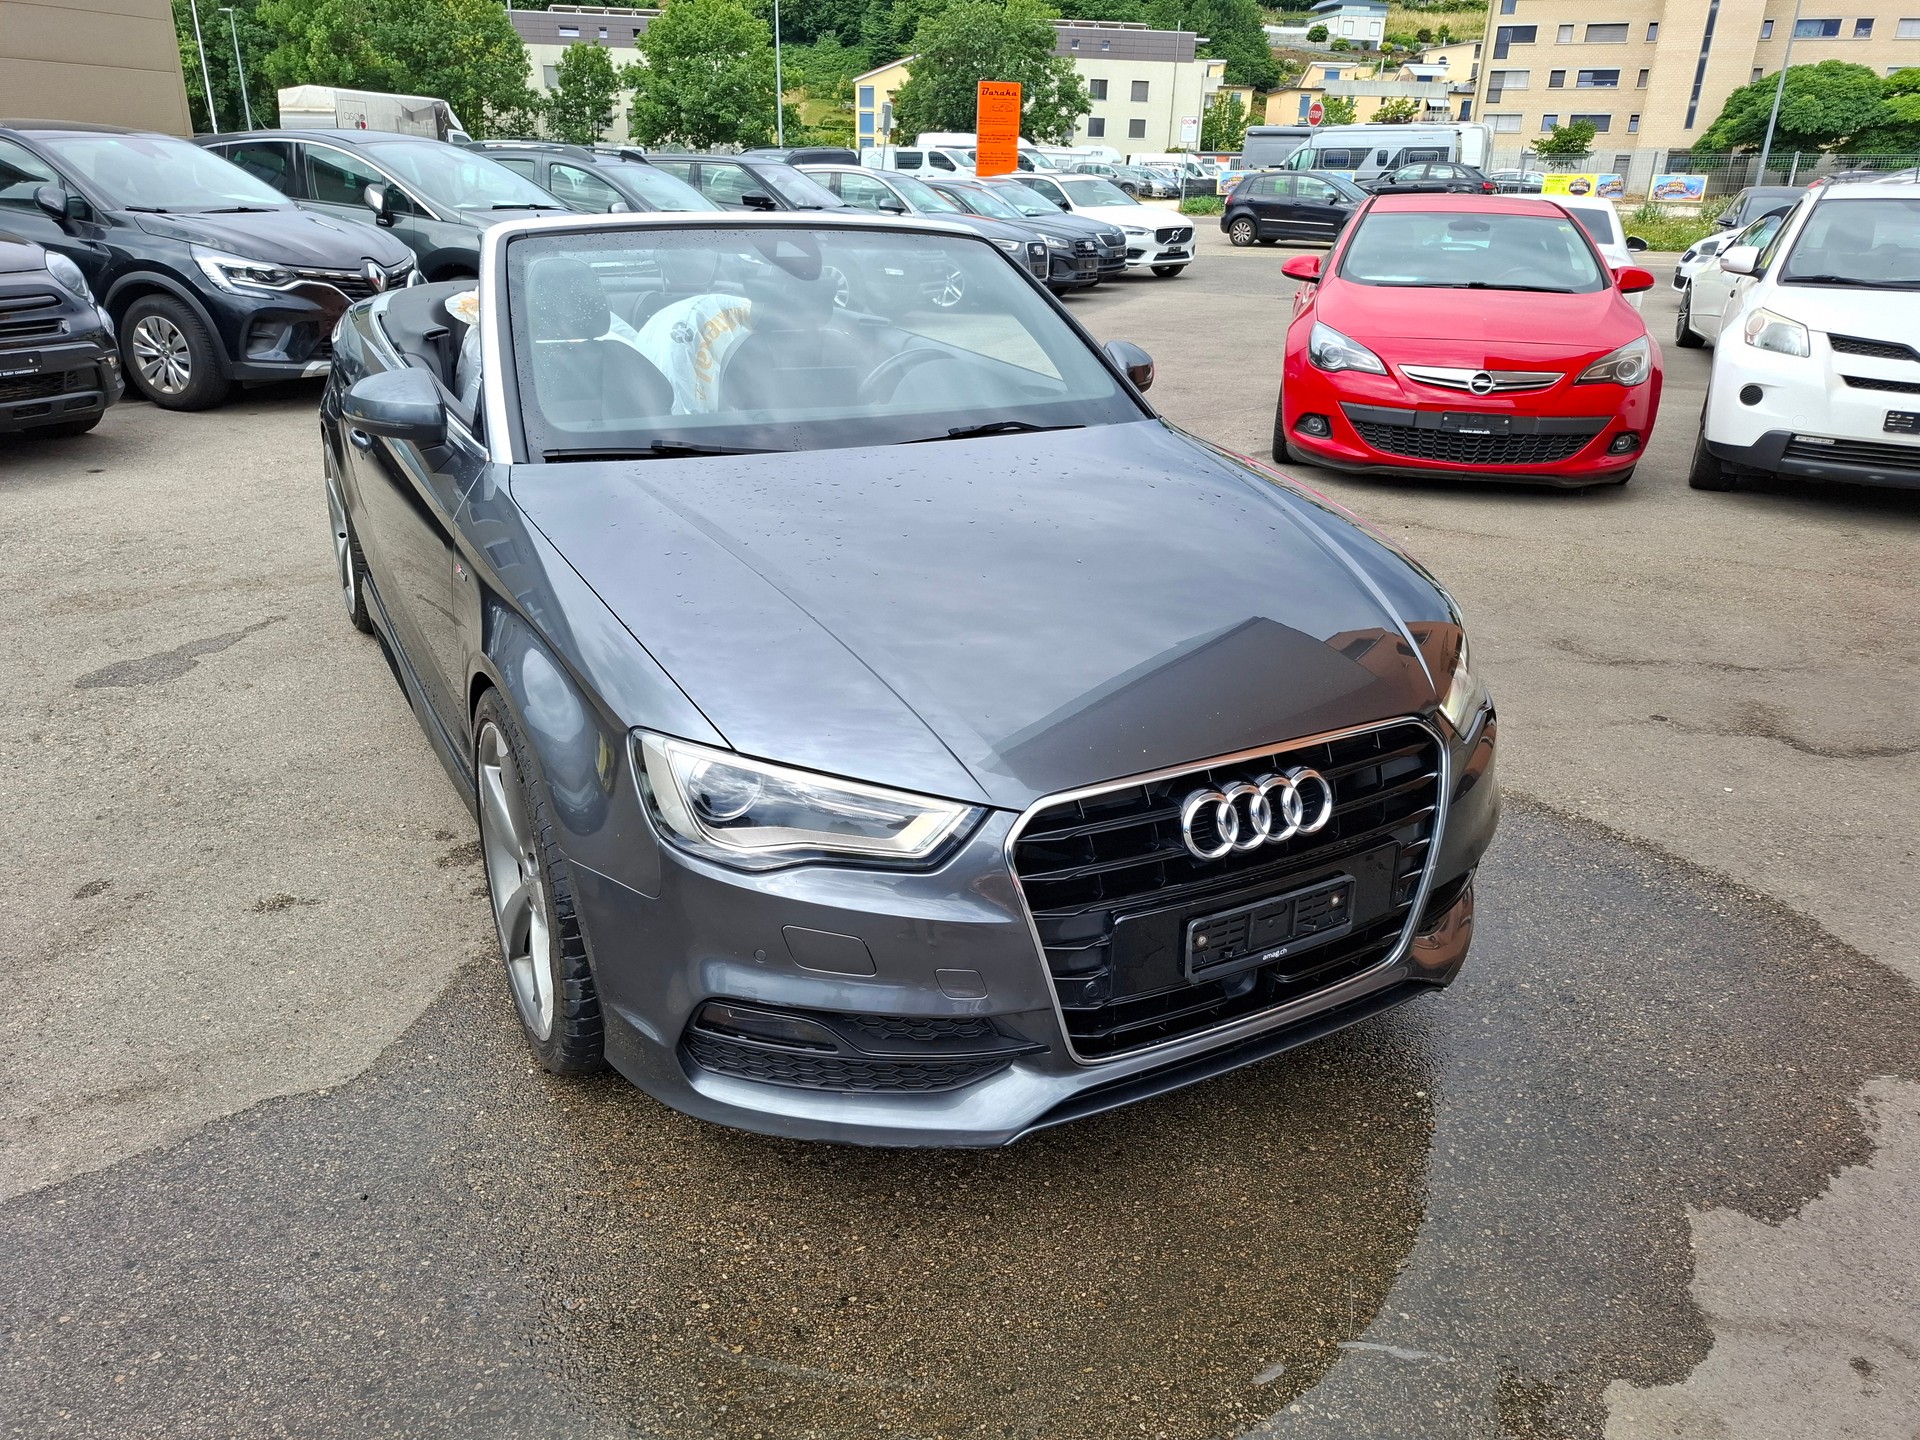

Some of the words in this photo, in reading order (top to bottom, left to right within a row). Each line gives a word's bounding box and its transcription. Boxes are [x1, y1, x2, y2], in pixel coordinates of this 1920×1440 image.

[981, 87, 1018, 97] Baraka
[1310, 110, 1322, 119] STOP
[1262, 948, 1288, 961] amag.ch
